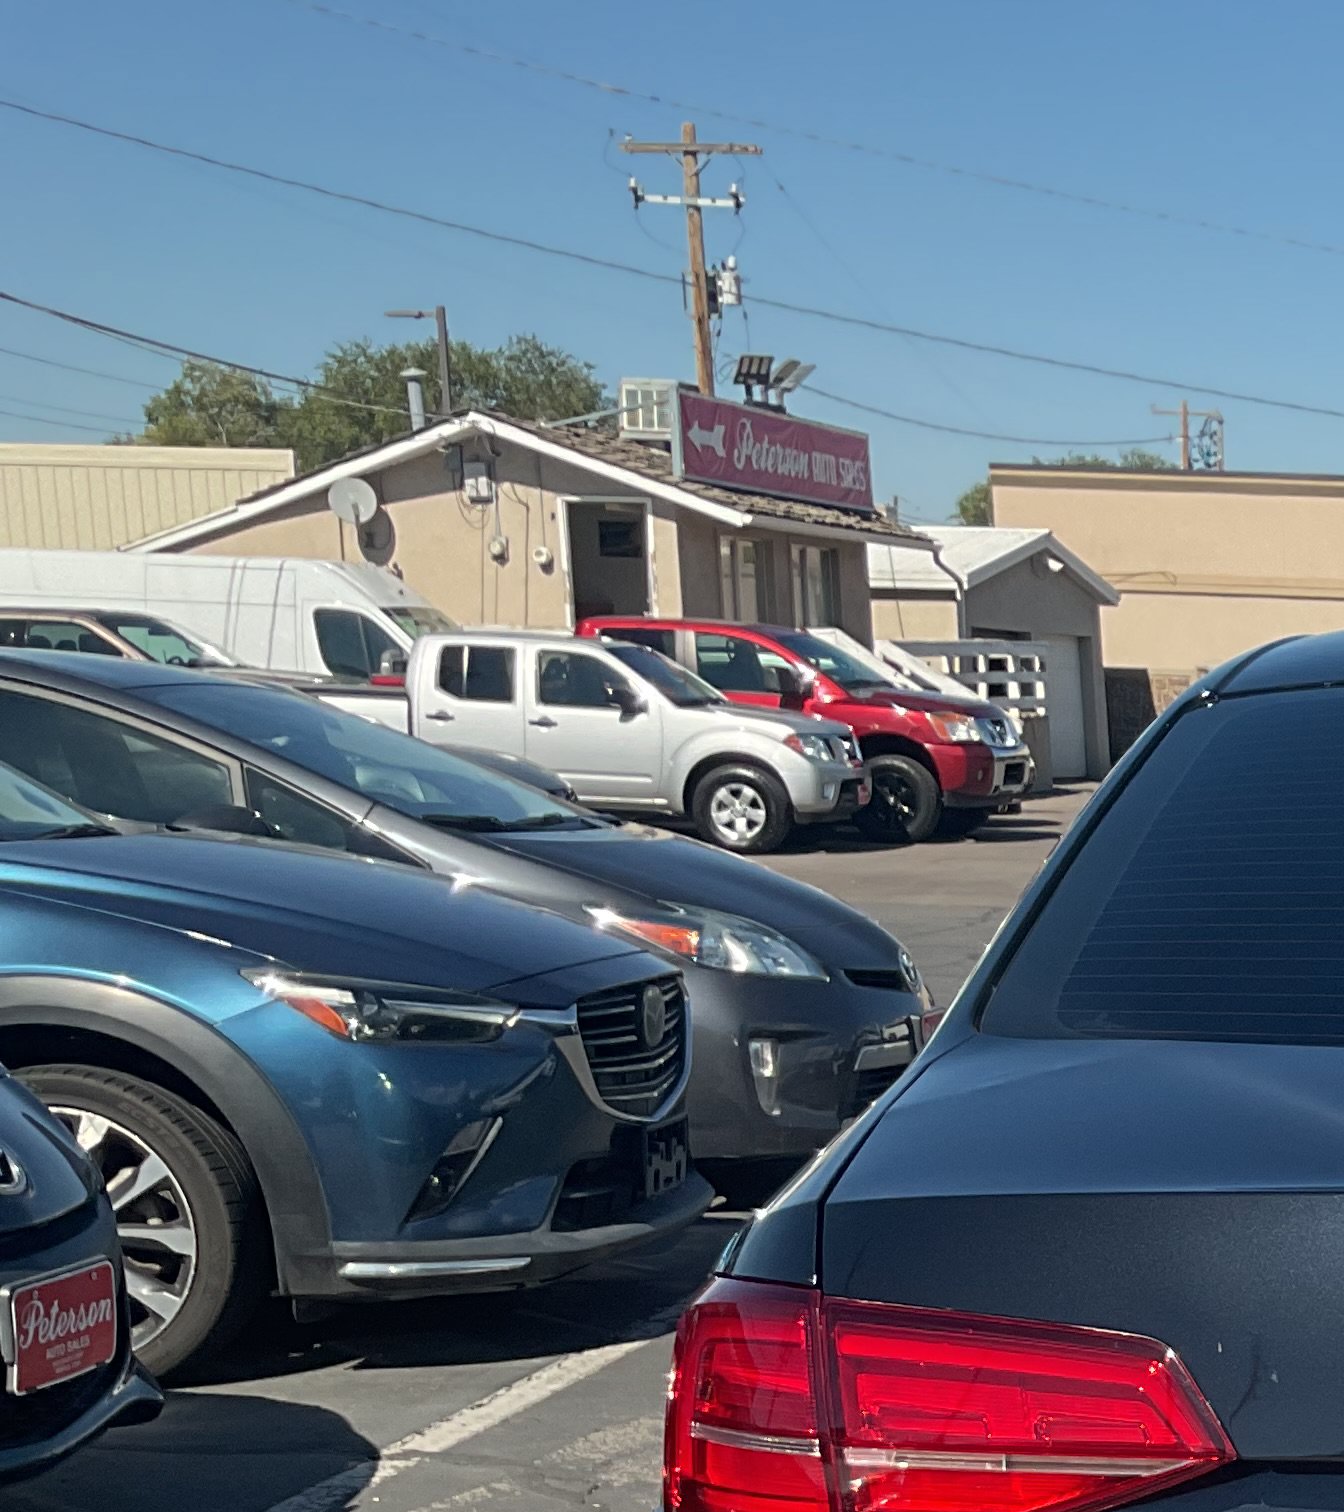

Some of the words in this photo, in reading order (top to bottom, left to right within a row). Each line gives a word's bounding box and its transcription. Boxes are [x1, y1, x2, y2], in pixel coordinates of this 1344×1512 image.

[733, 418, 809, 480] Peterson
[812, 451, 836, 486] AUTO
[19, 1298, 113, 1349] Peterson
